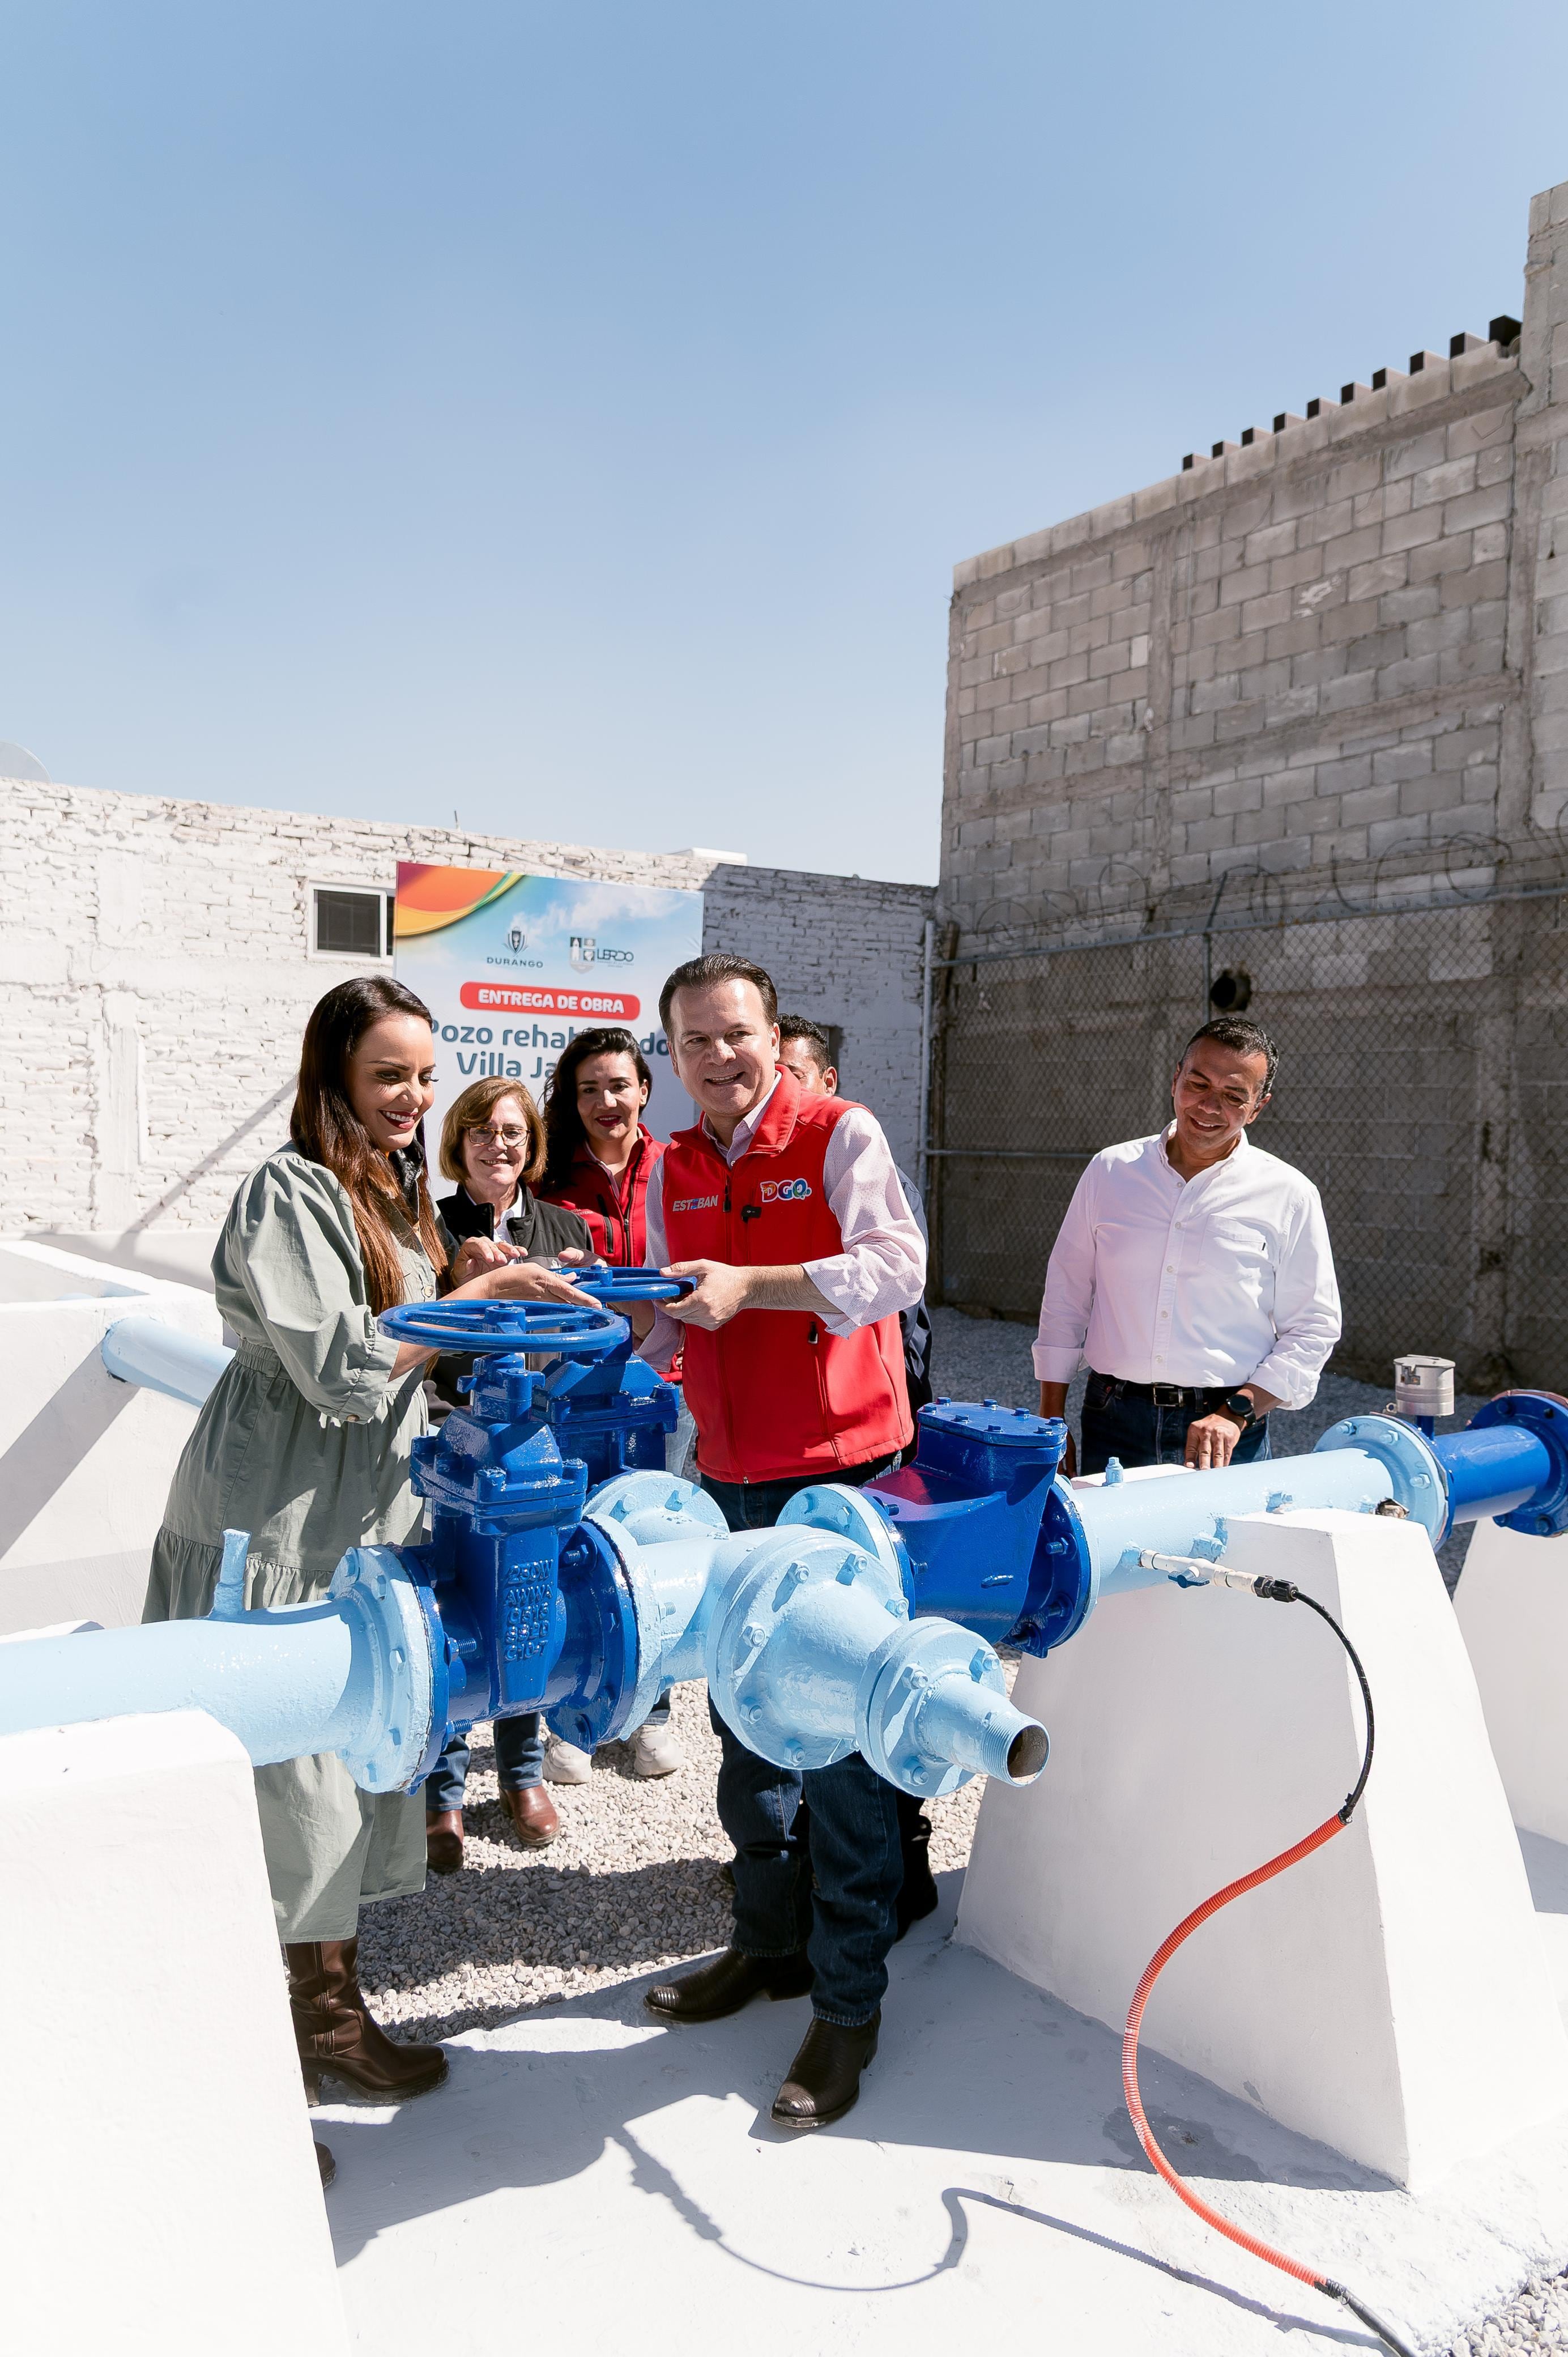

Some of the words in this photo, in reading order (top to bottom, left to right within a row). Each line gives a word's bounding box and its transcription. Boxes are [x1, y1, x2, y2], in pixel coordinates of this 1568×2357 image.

[487, 957, 544, 968] DURANGO
[597, 948, 634, 962] LERDO
[478, 989, 555, 1009] ENTREGA
[557, 994, 578, 1010] DE
[580, 996, 625, 1014] OBRA
[456, 1050, 522, 1077] Villa
[672, 1194, 719, 1212] ESTEBAN
[504, 1584, 553, 1607] AWWA
